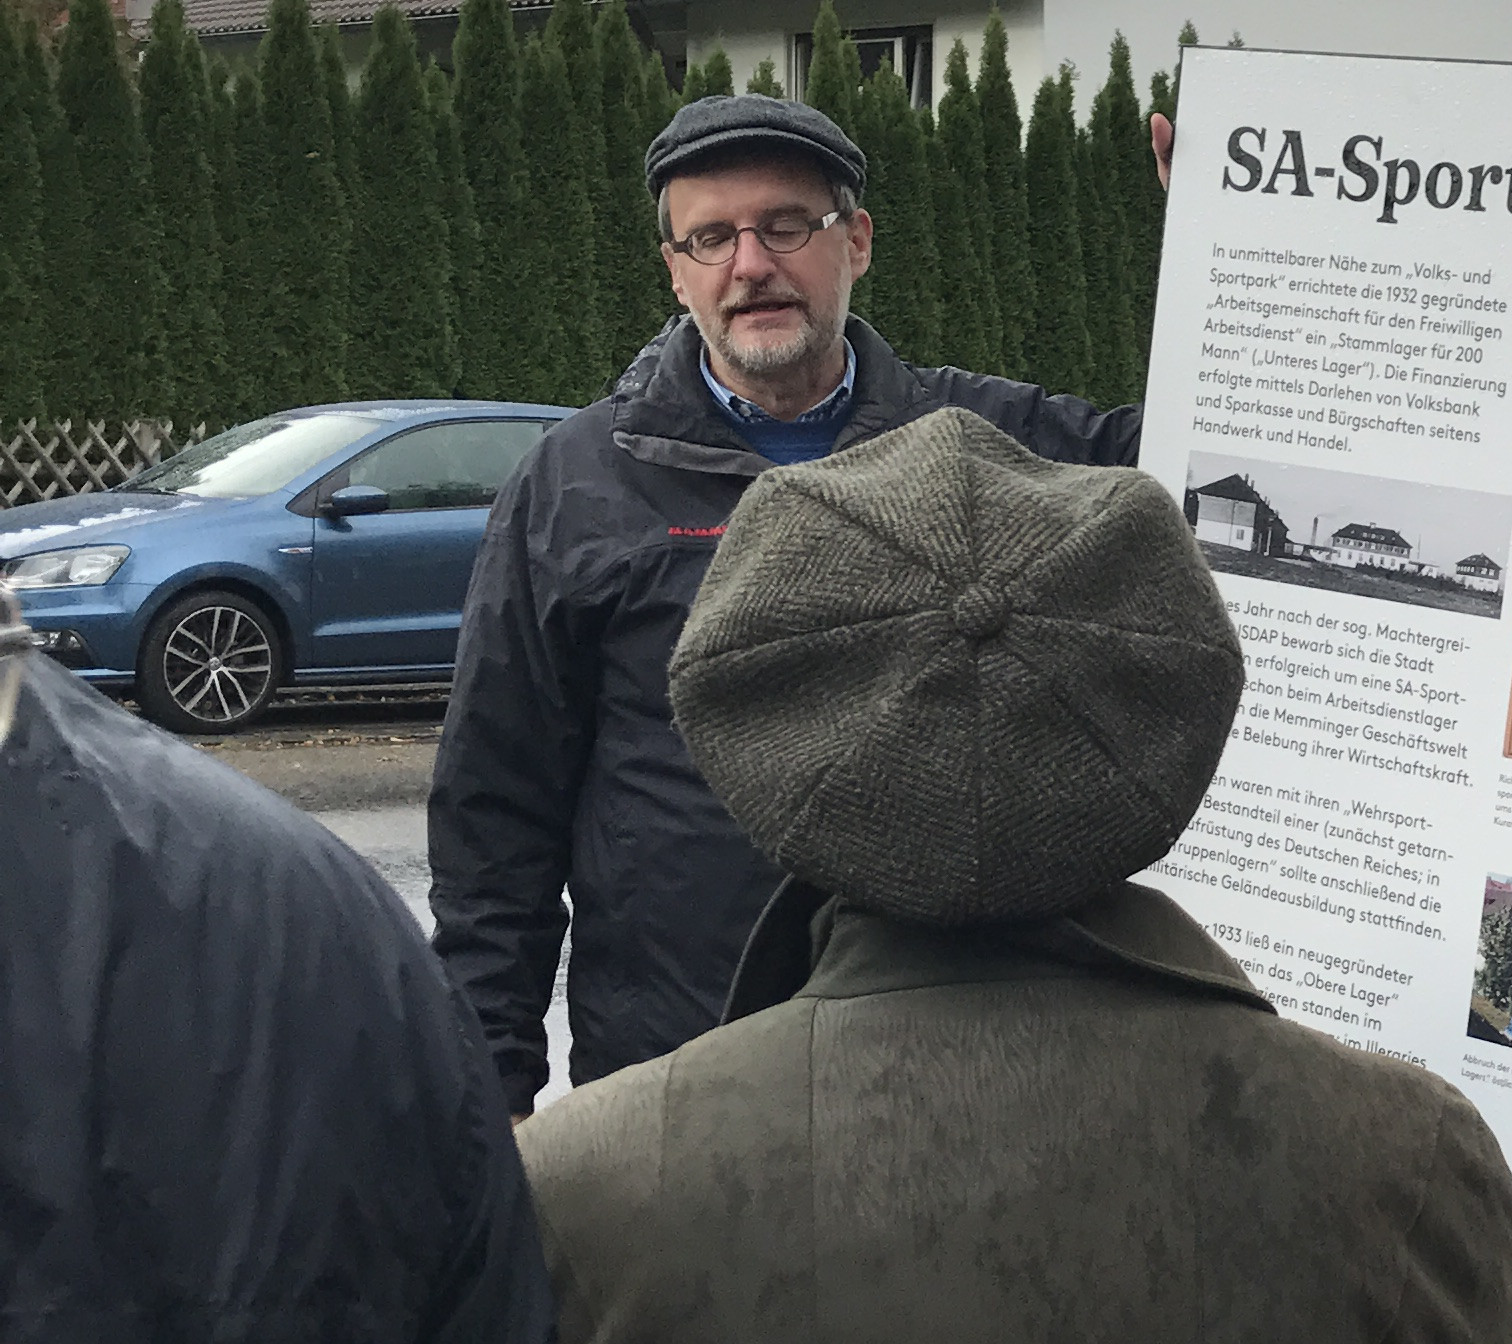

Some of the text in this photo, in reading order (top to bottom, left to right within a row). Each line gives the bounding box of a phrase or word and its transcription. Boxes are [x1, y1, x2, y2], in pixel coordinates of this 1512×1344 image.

[1211, 241, 1225, 258] In
[1228, 246, 1326, 268] unmittelbarer
[1328, 253, 1368, 273] Nähe
[1369, 261, 1402, 276] zum
[1461, 268, 1492, 285] und
[1287, 277, 1357, 298] errichtete
[1359, 282, 1383, 300] die
[1385, 285, 1418, 304] 1932
[1419, 292, 1508, 313] gegründete
[1304, 328, 1327, 346] ein
[1430, 342, 1453, 360] für
[1454, 345, 1483, 364] 200
[1363, 308, 1386, 326] für
[1387, 311, 1415, 330] den
[1418, 314, 1503, 342] Freiwilligen
[1197, 367, 1481, 417] erfolgte mittels Darlehen von Volksbank
[1383, 362, 1408, 381] Die
[1410, 366, 1507, 399] Finanzierung
[1191, 415, 1352, 452] Handwerk und Handel.
[1194, 393, 1481, 443] und Sparkasse und Bürgschaften seitens
[1234, 623, 1435, 674] SDAP bewarb sich die Stadt
[1242, 599, 1275, 619] Jahr
[1276, 609, 1312, 626] nach
[1315, 612, 1340, 630] der
[1341, 620, 1372, 640] sog.
[1374, 622, 1471, 654] Machtergrei-
[1254, 654, 1330, 680] erfolgreich
[1333, 670, 1357, 686] um
[1360, 672, 1392, 692] eine
[1393, 677, 1466, 705] SA-Sport-
[1248, 701, 1468, 760] die Memminger Geschäftswelt
[1286, 682, 1322, 705] beim
[1323, 691, 1458, 733] Arbeitsdienstlager
[1242, 725, 1474, 787] Belebung ihrer Wirtschaftskraft.
[1230, 777, 1273, 797] waren
[1275, 786, 1301, 803] mit
[1303, 789, 1340, 812] ihren
[1188, 816, 1440, 886] ufrüstung des Deutschen Reiches; in
[1202, 793, 1454, 862] Bestandteil einer (zunächst getarn-
[1148, 861, 1446, 942] ilitärische Geländeausbildung stattfinden.
[1278, 864, 1317, 884] sollte
[1319, 875, 1416, 907] anschließend
[1418, 894, 1442, 913] die
[1211, 921, 1242, 943] 1933
[1244, 929, 1270, 950] ließ
[1272, 938, 1294, 957] ein
[1297, 947, 1414, 986] neugegründeter
[1267, 962, 1293, 982] das
[1301, 999, 1382, 1032] standen im
